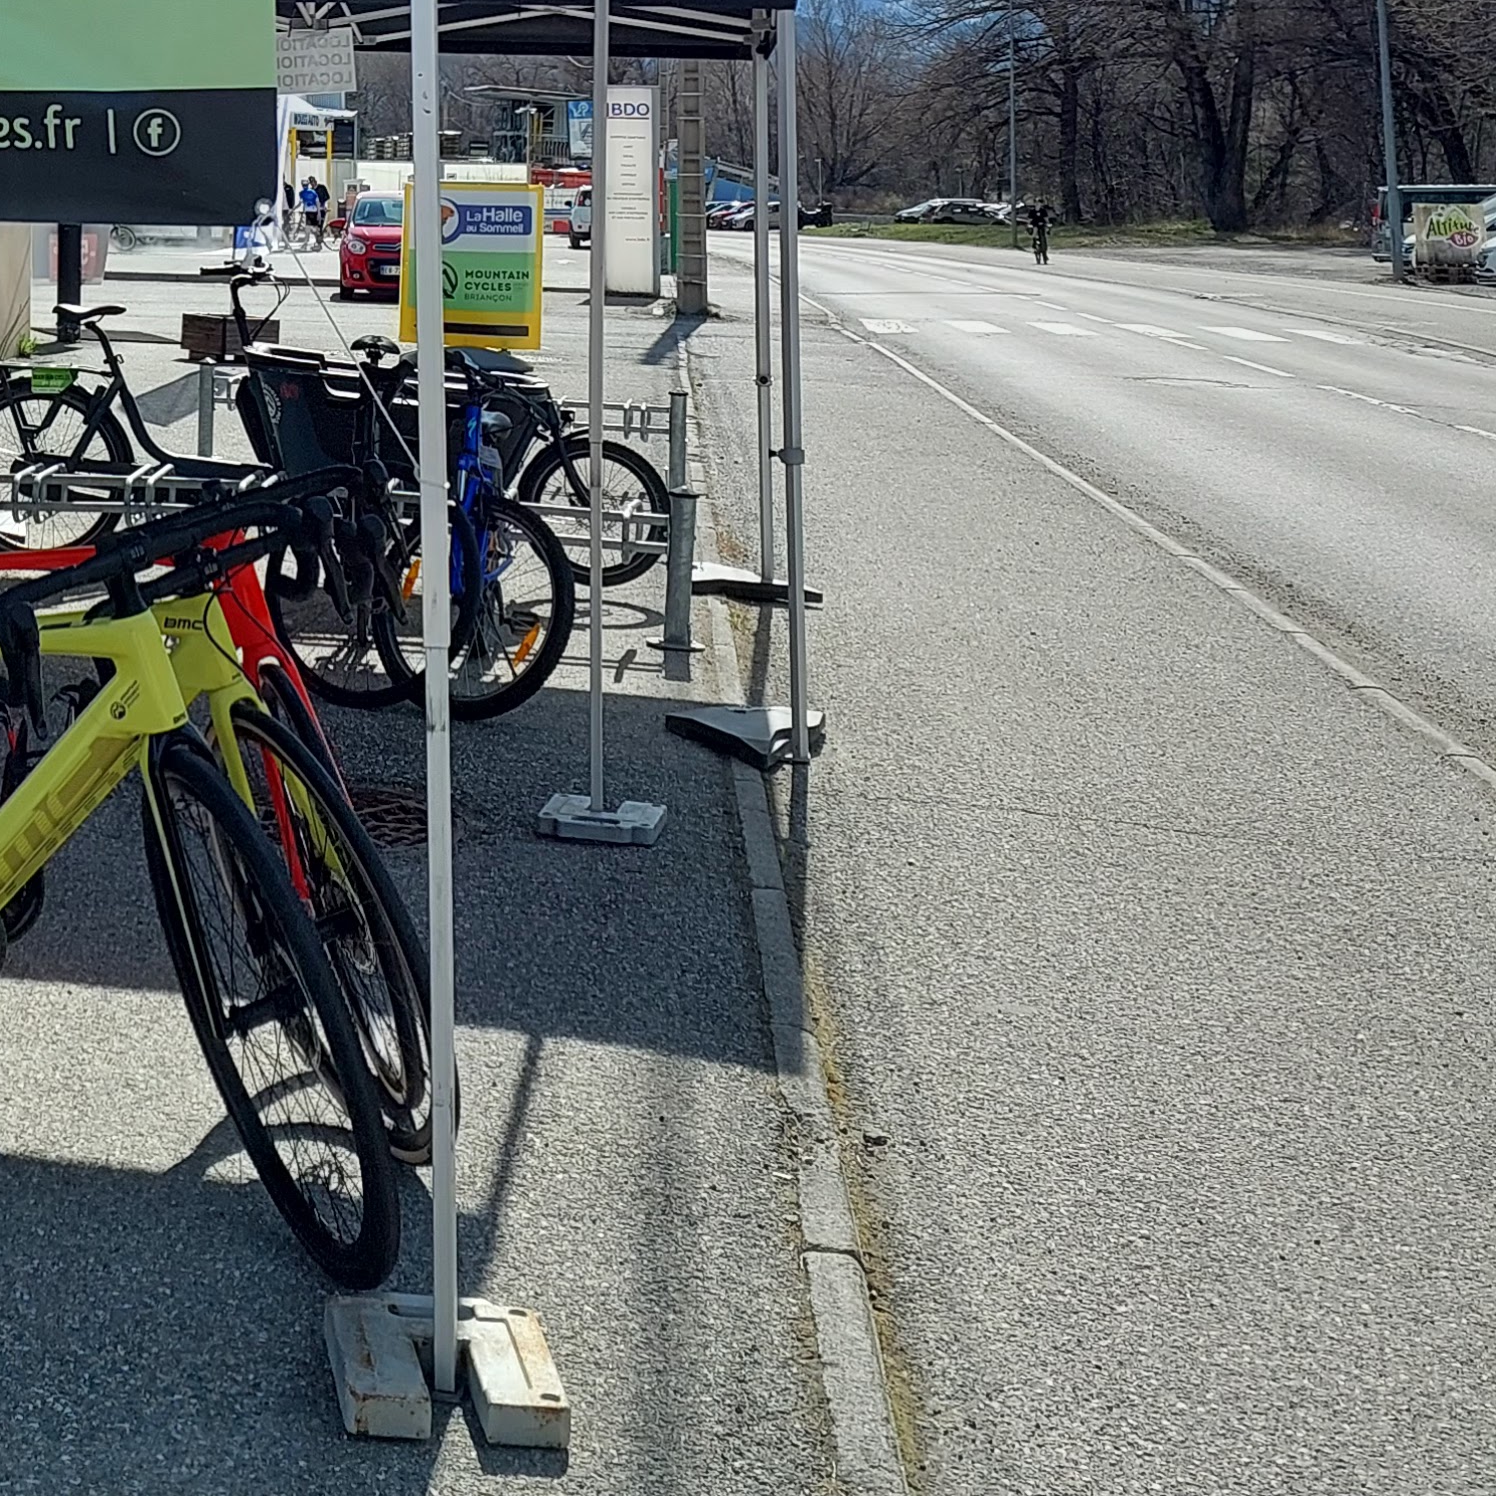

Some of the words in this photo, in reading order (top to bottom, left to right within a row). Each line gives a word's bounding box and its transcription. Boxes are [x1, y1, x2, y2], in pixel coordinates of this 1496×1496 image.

[611, 102, 650, 116] BDO
[482, 207, 523, 223] Halle
[466, 224, 477, 233] au
[479, 222, 524, 234] Sommeil
[1454, 232, 1474, 246] Bio
[464, 269, 530, 281] MOUNTAIN
[464, 281, 512, 292] CYCLES
[464, 293, 513, 303] BRIANÇON
[163, 616, 203, 631] BMC
